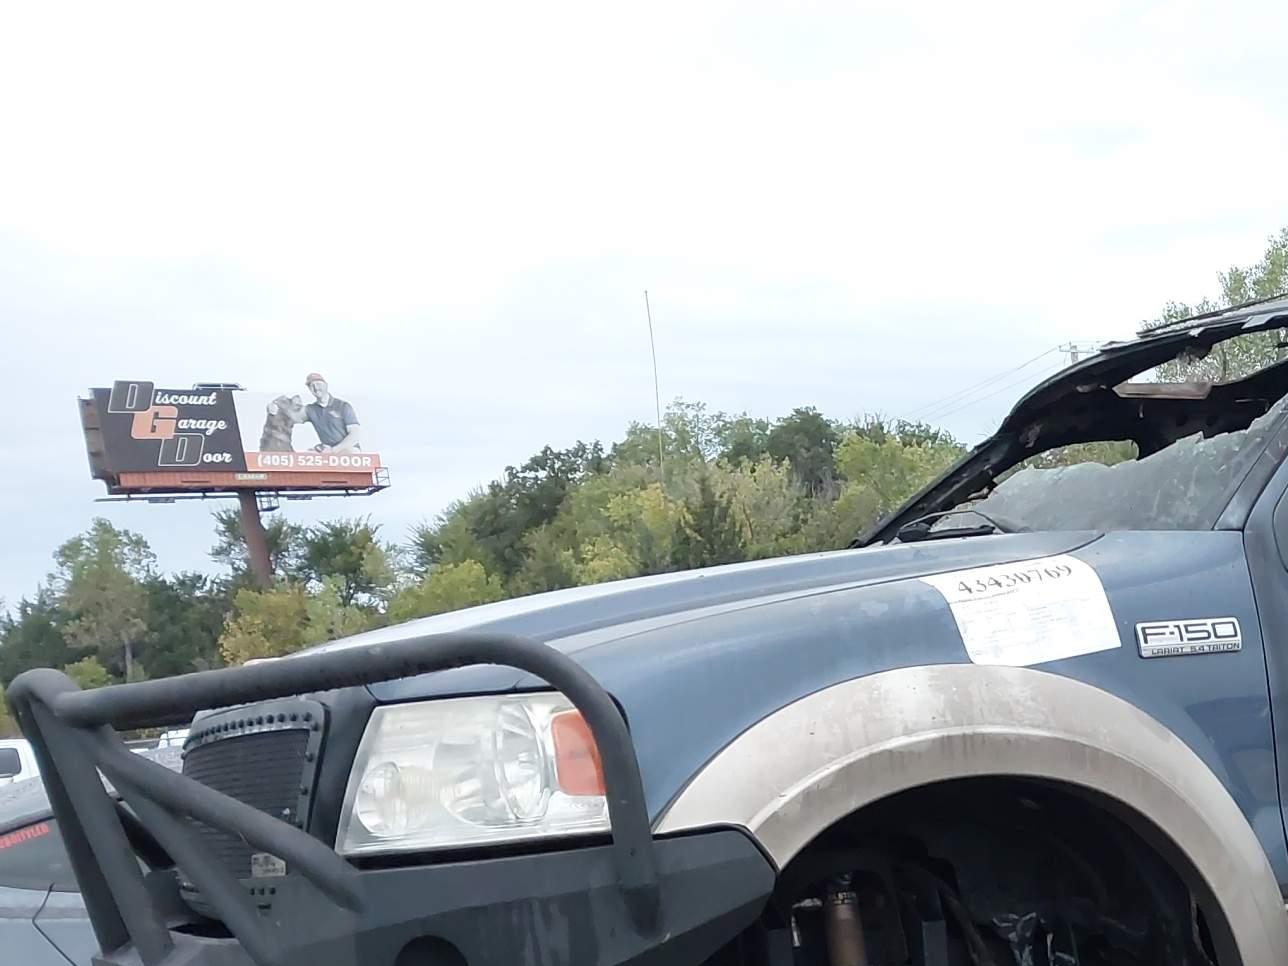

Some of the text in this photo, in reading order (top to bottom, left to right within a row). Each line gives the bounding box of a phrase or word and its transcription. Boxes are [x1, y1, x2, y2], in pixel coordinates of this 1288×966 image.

[108, 380, 217, 413] Discount
[131, 405, 227, 439] Garage
[158, 433, 233, 466] Door
[257, 454, 372, 467] (405) 525-DOOR
[958, 565, 1072, 594] 43430769
[1141, 621, 1238, 644] F-150
[1151, 646, 1184, 656] LARIAT
[1208, 642, 1240, 652] TRITON
